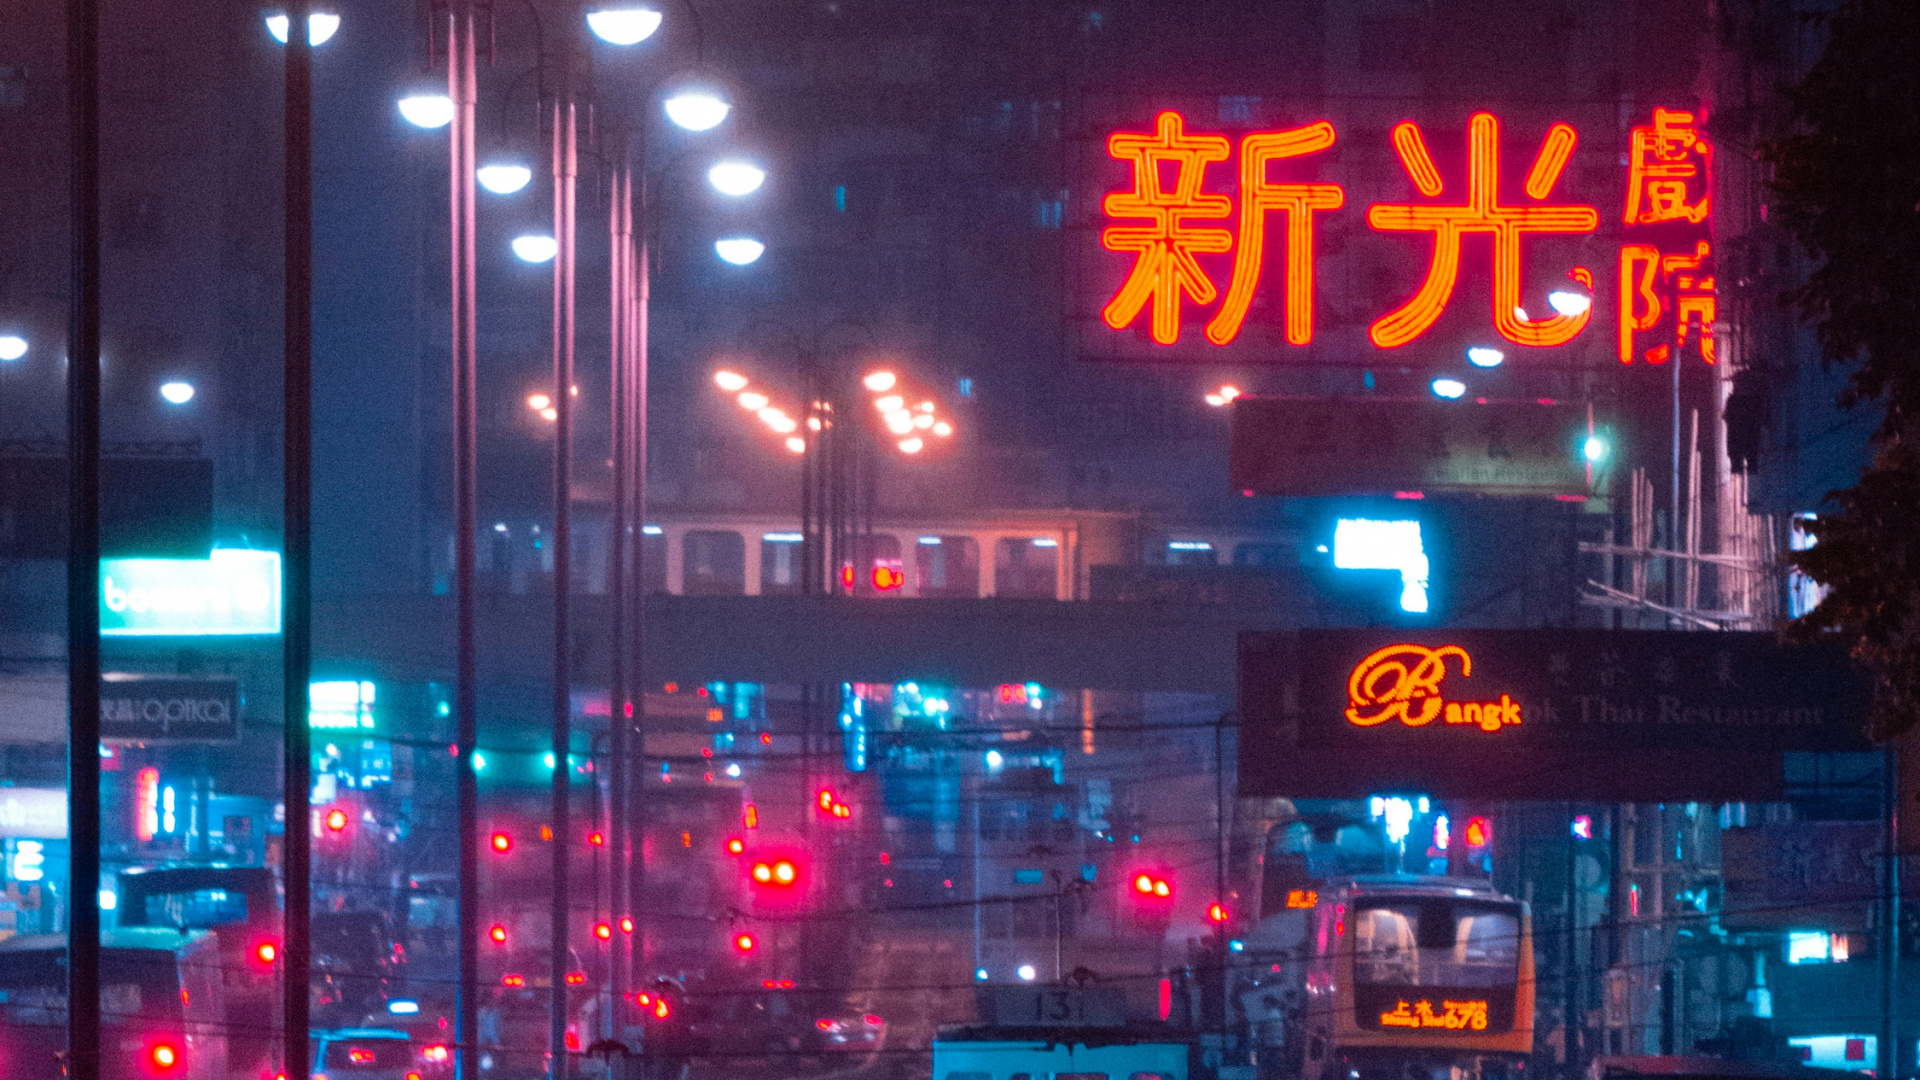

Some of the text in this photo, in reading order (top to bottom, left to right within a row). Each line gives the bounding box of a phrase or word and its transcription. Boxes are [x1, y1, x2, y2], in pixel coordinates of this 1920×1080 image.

[1103, 111, 1598, 347] 新光
[1574, 694, 1645, 724] Thai
[1445, 1009, 1488, 1030] 678
